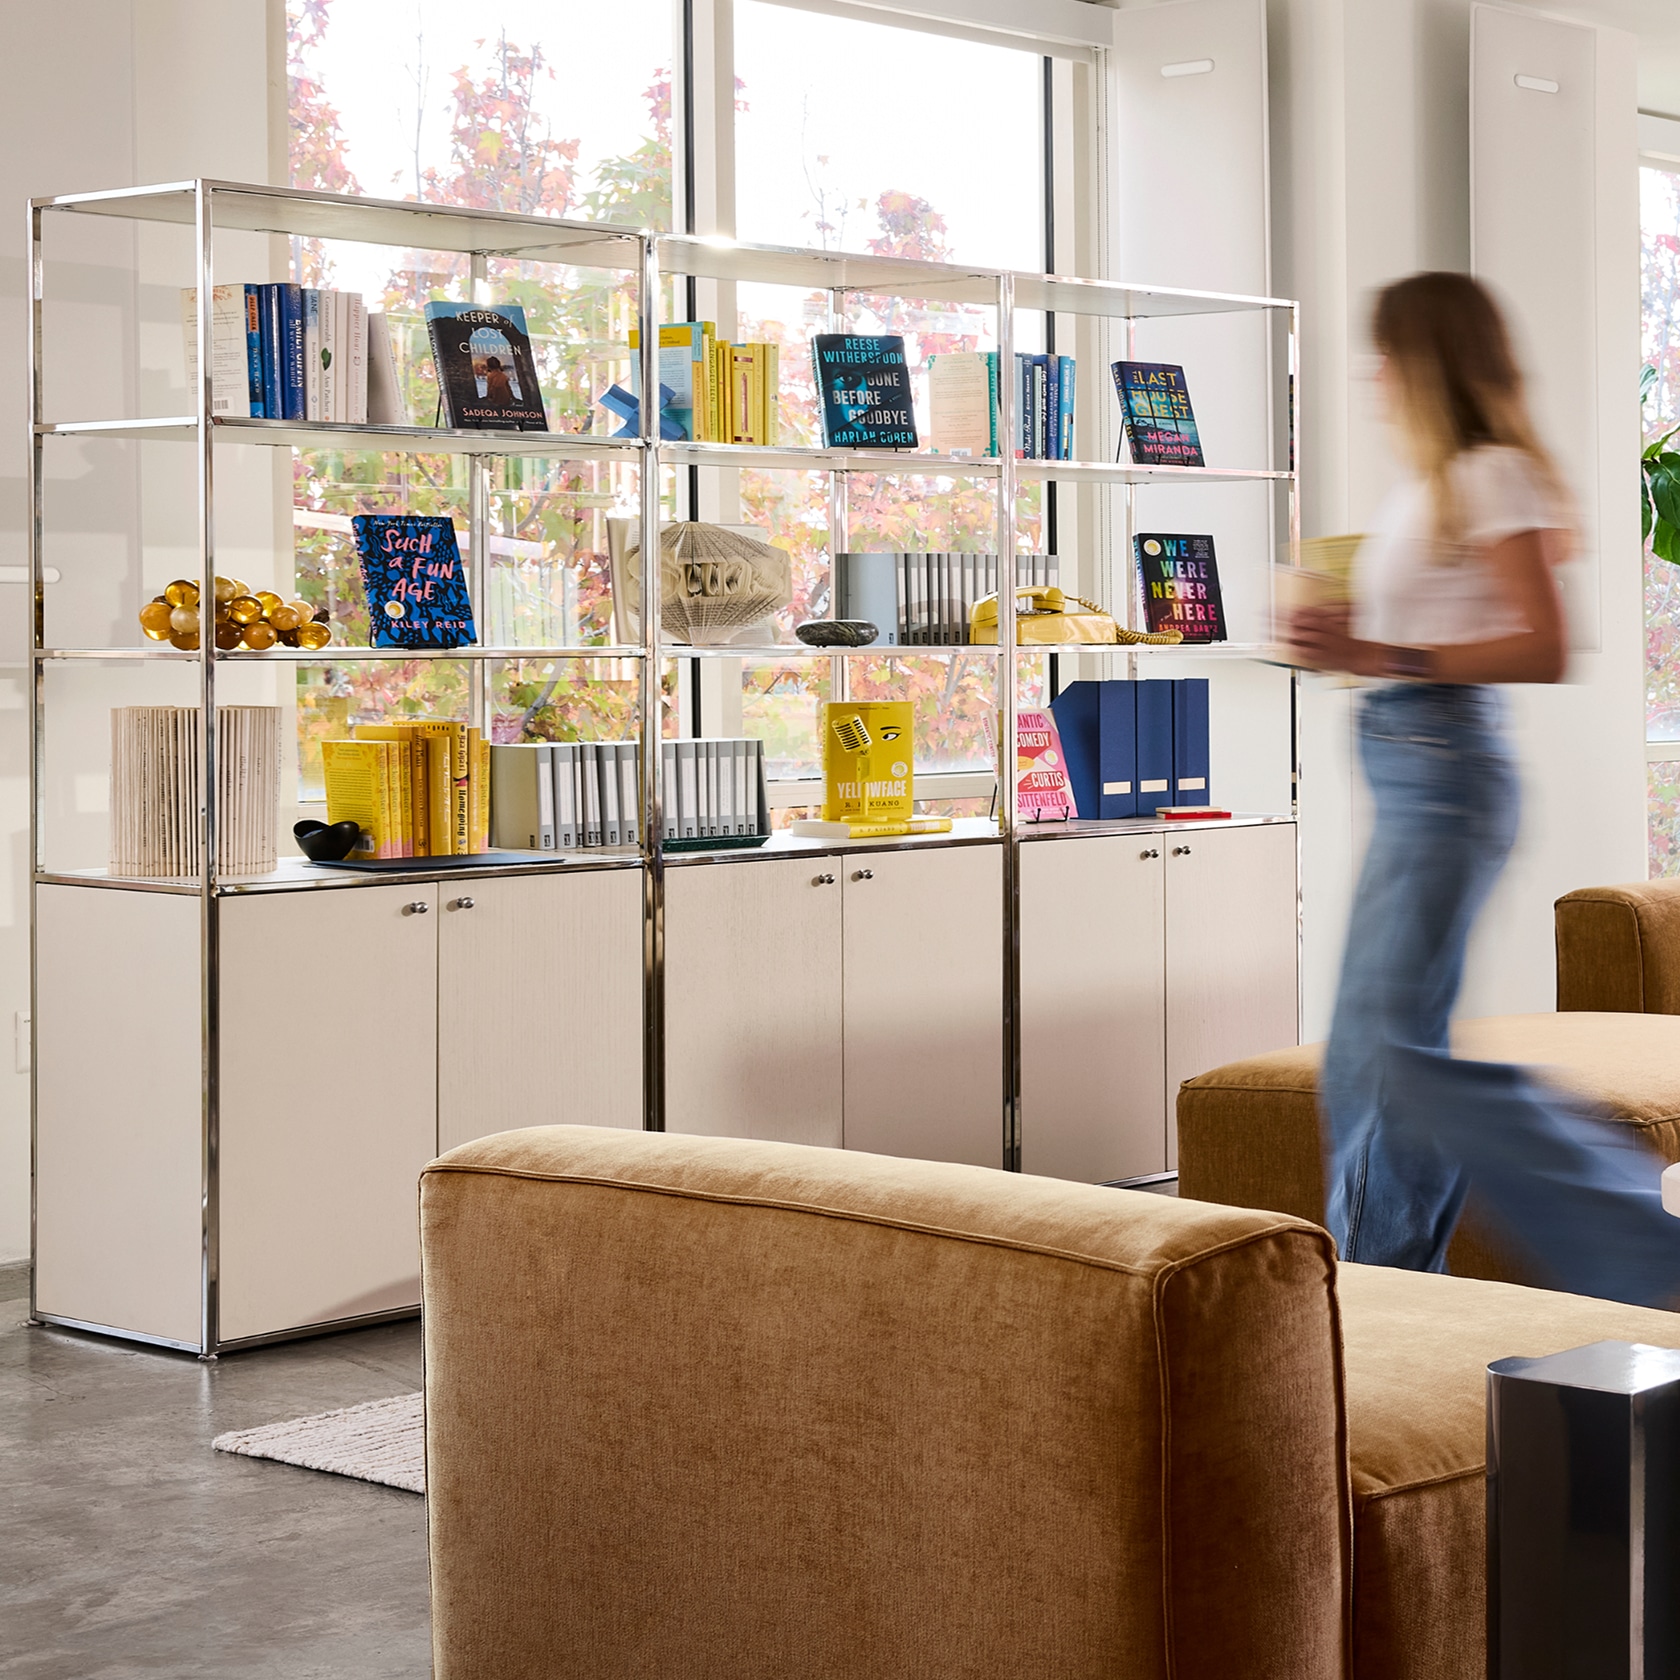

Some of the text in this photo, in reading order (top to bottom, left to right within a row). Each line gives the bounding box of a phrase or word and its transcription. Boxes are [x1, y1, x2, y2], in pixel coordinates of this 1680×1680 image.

[455, 310, 515, 328] KEEPER of
[471, 327, 503, 340] LOST
[459, 341, 522, 356] CHILDREN
[844, 338, 880, 351] REESE
[823, 350, 904, 364] WITHERSPOON
[867, 371, 901, 387] GONE
[1137, 370, 1177, 386] LAST
[832, 390, 882, 405] BEFORE
[1130, 387, 1187, 404] HOUSE
[462, 407, 543, 419] SADEQA JOHNSON
[848, 409, 909, 425] GOODBYE
[1135, 403, 1189, 419] GUEST
[834, 431, 914, 444] HARLAN COBEN
[1147, 431, 1190, 443] MEGAN
[1143, 443, 1198, 456] MIRANDA
[1162, 539, 1189, 557] WE
[1160, 560, 1209, 579] WERE
[391, 577, 437, 603] AGE
[1151, 581, 1207, 600] NEVER
[1172, 603, 1218, 621] HERE
[391, 620, 467, 629] KILEY REID
[1158, 623, 1191, 633] ANDREA
[1017, 714, 1044, 728] ANTIC
[1016, 732, 1050, 748] COMEDY
[1031, 772, 1065, 788] CURTIS
[1017, 792, 1067, 808] SITTENFELD
[457, 789, 467, 837] Homegoing
